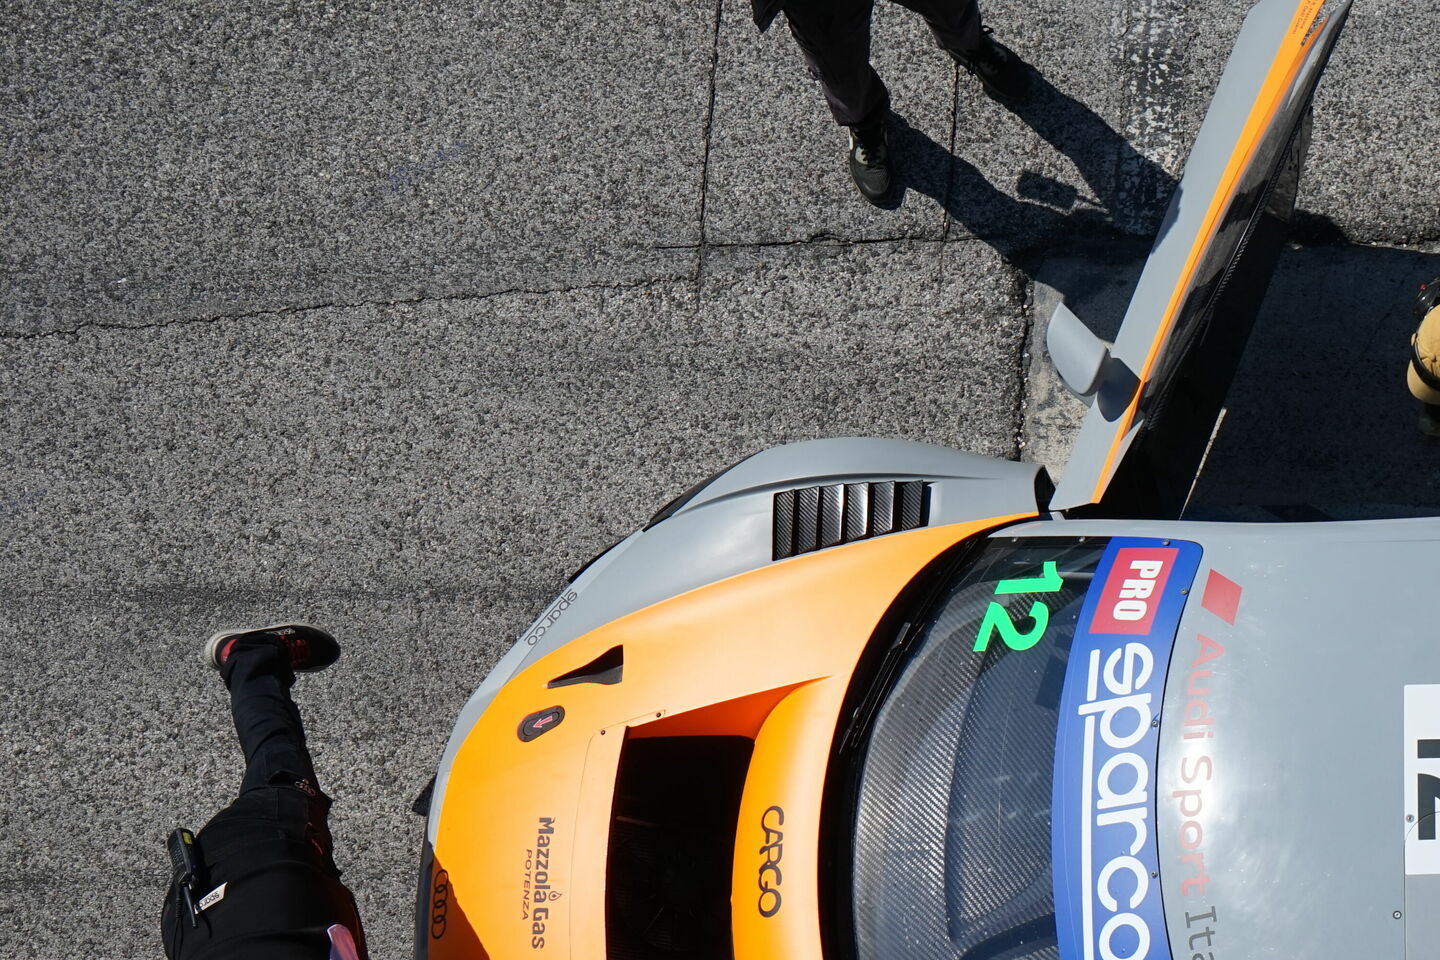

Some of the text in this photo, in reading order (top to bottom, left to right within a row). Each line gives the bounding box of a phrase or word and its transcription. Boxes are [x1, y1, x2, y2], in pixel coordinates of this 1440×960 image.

[524, 588, 578, 646] sparco
[973, 560, 1064, 652] 12
[1113, 560, 1164, 621] PRO
[1184, 633, 1225, 740] Audi
[758, 805, 784, 918] CARGO
[1172, 755, 1213, 897] Sport
[522, 849, 533, 921] POTENZA
[531, 907, 549, 950] Gas
